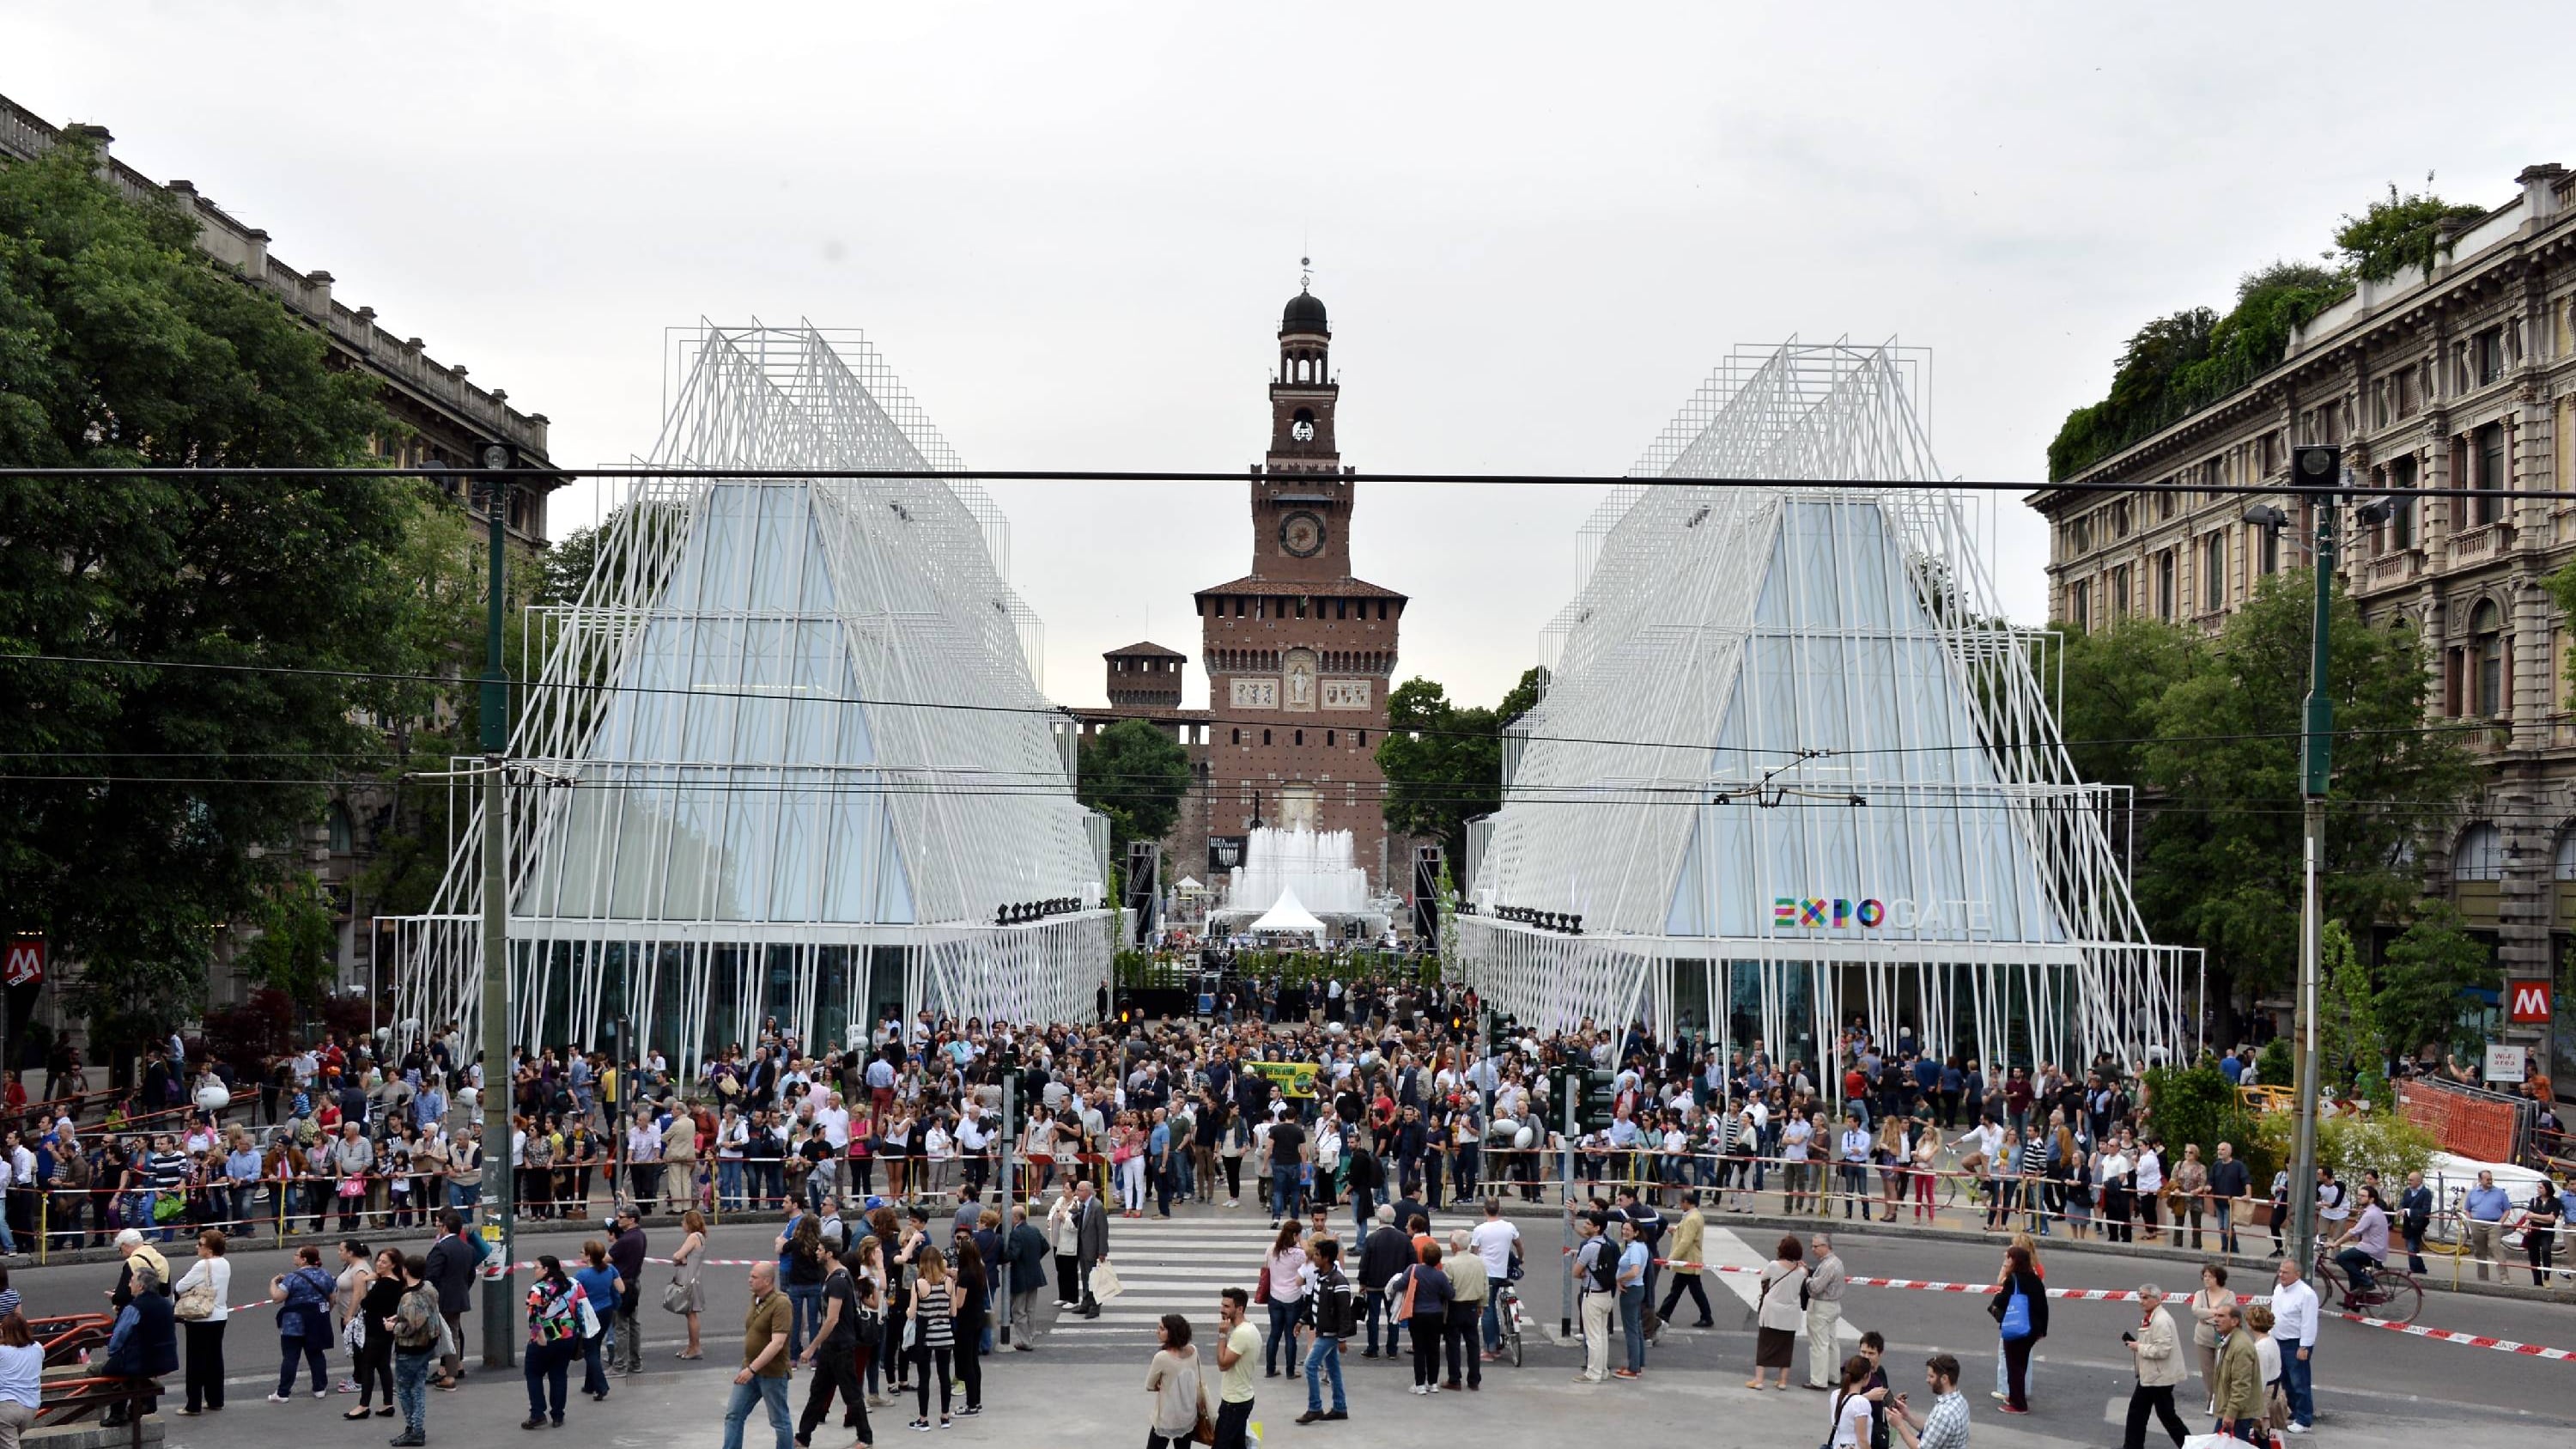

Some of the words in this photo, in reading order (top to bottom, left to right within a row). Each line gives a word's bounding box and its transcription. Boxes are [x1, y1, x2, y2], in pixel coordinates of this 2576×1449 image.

[7, 948, 41, 974] M
[2513, 989, 2548, 1014] M
[2476, 1337, 2507, 1349] POLIZIA
[2508, 1342, 2542, 1355] LOCALE
